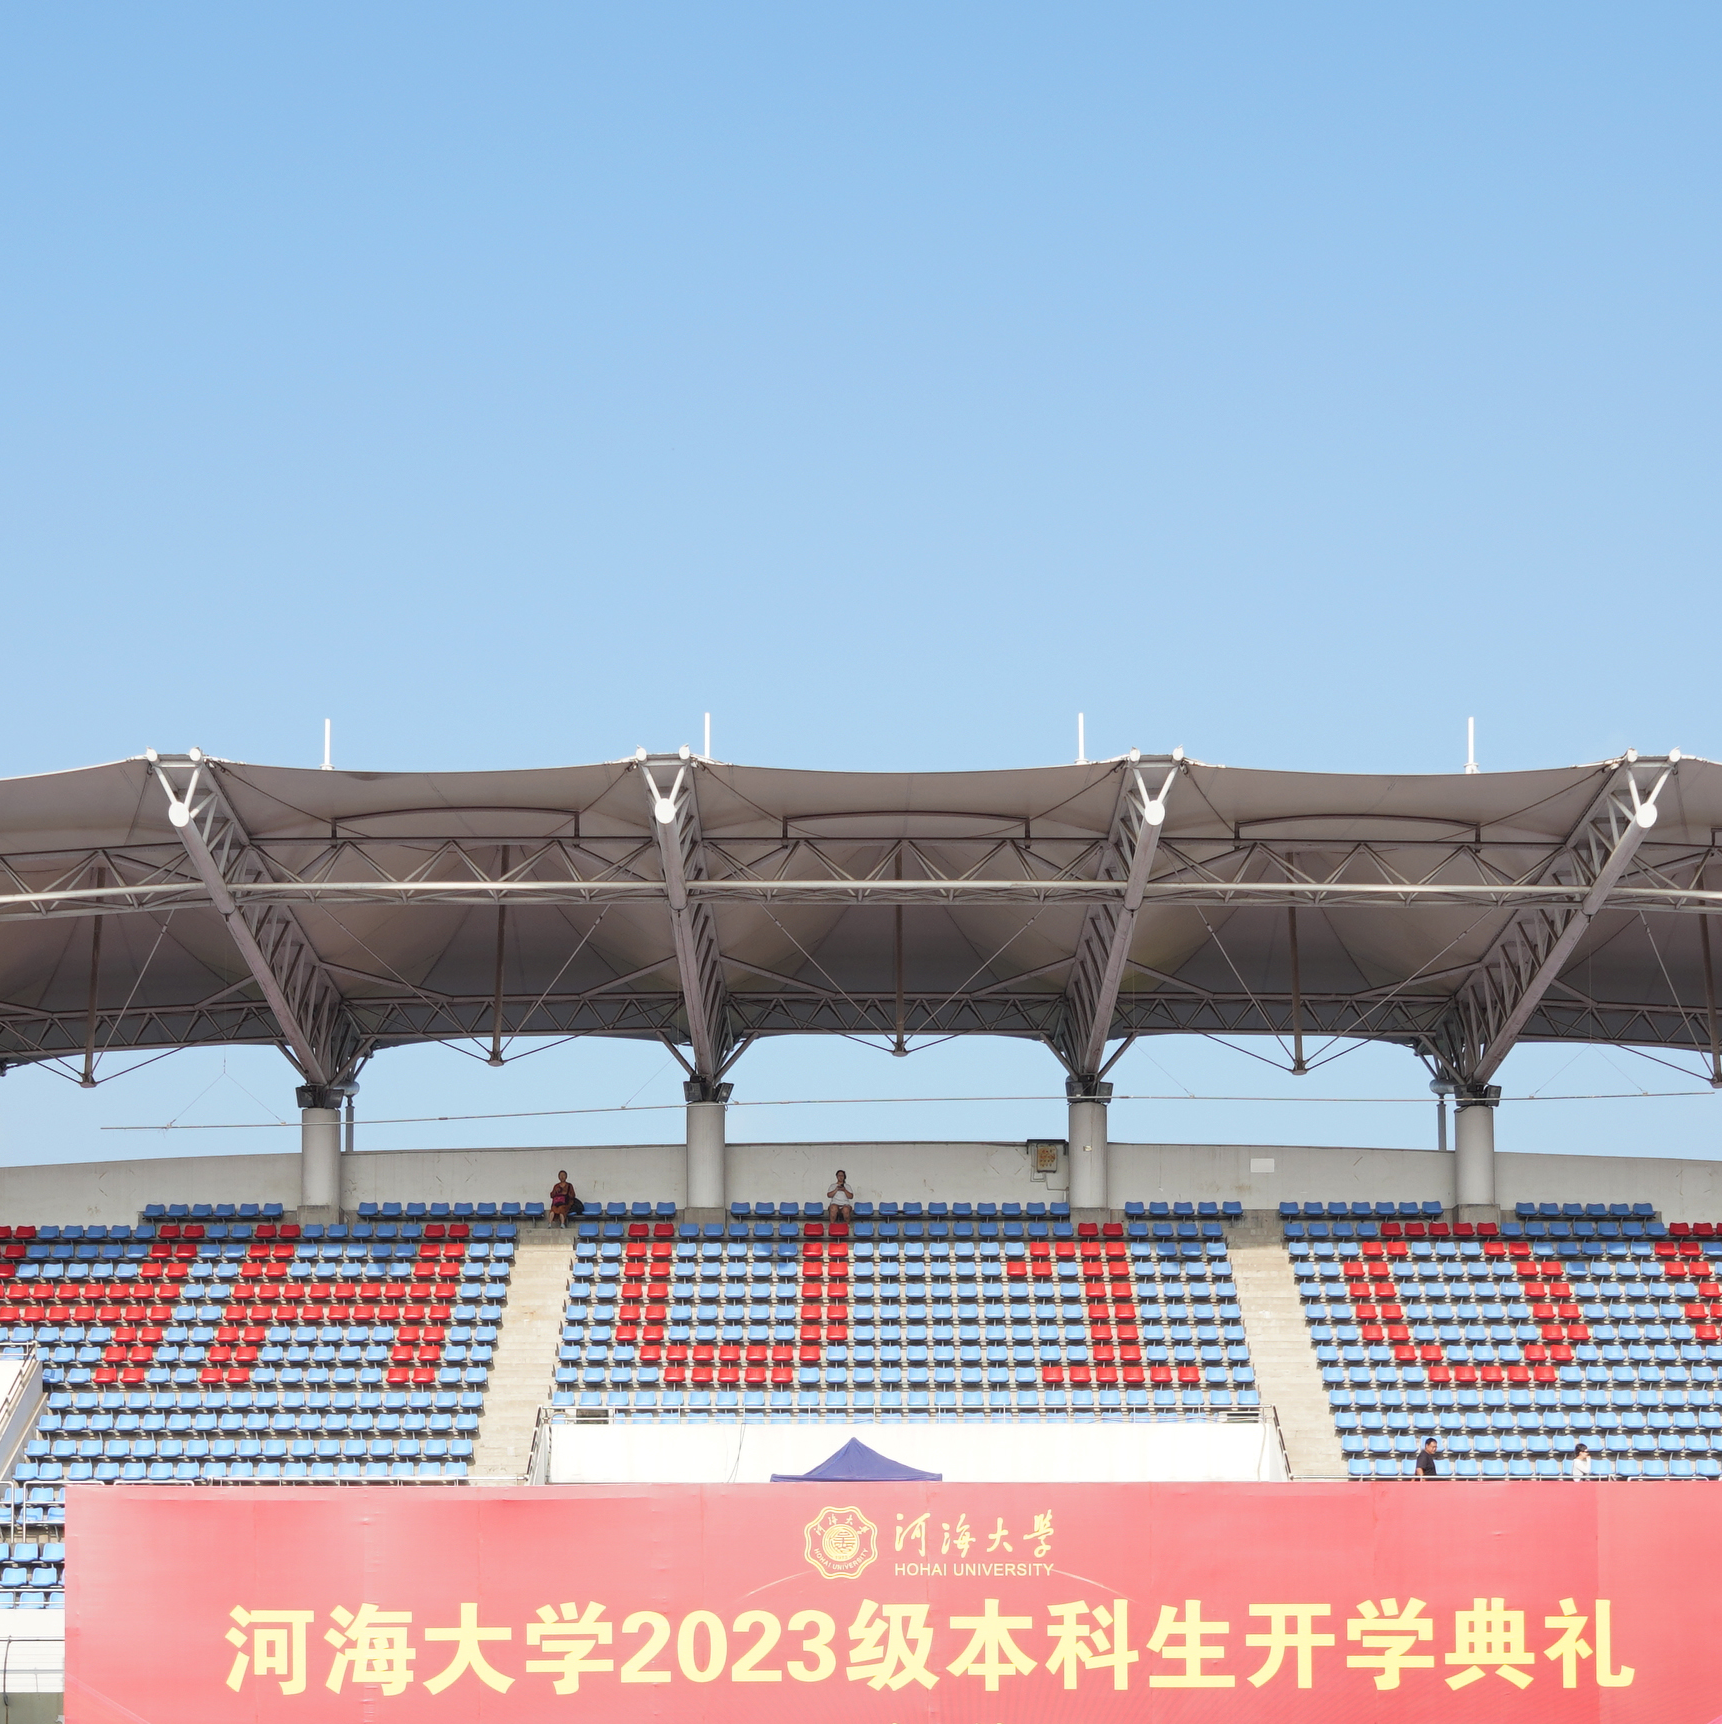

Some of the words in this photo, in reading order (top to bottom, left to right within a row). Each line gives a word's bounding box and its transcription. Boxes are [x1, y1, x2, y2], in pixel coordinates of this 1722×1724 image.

[895, 1563, 947, 1577] HOHAI
[954, 1563, 1054, 1577] UNIVERSITY
[225, 1598, 1636, 1697] 河海大学2023级本科生开学典礼
